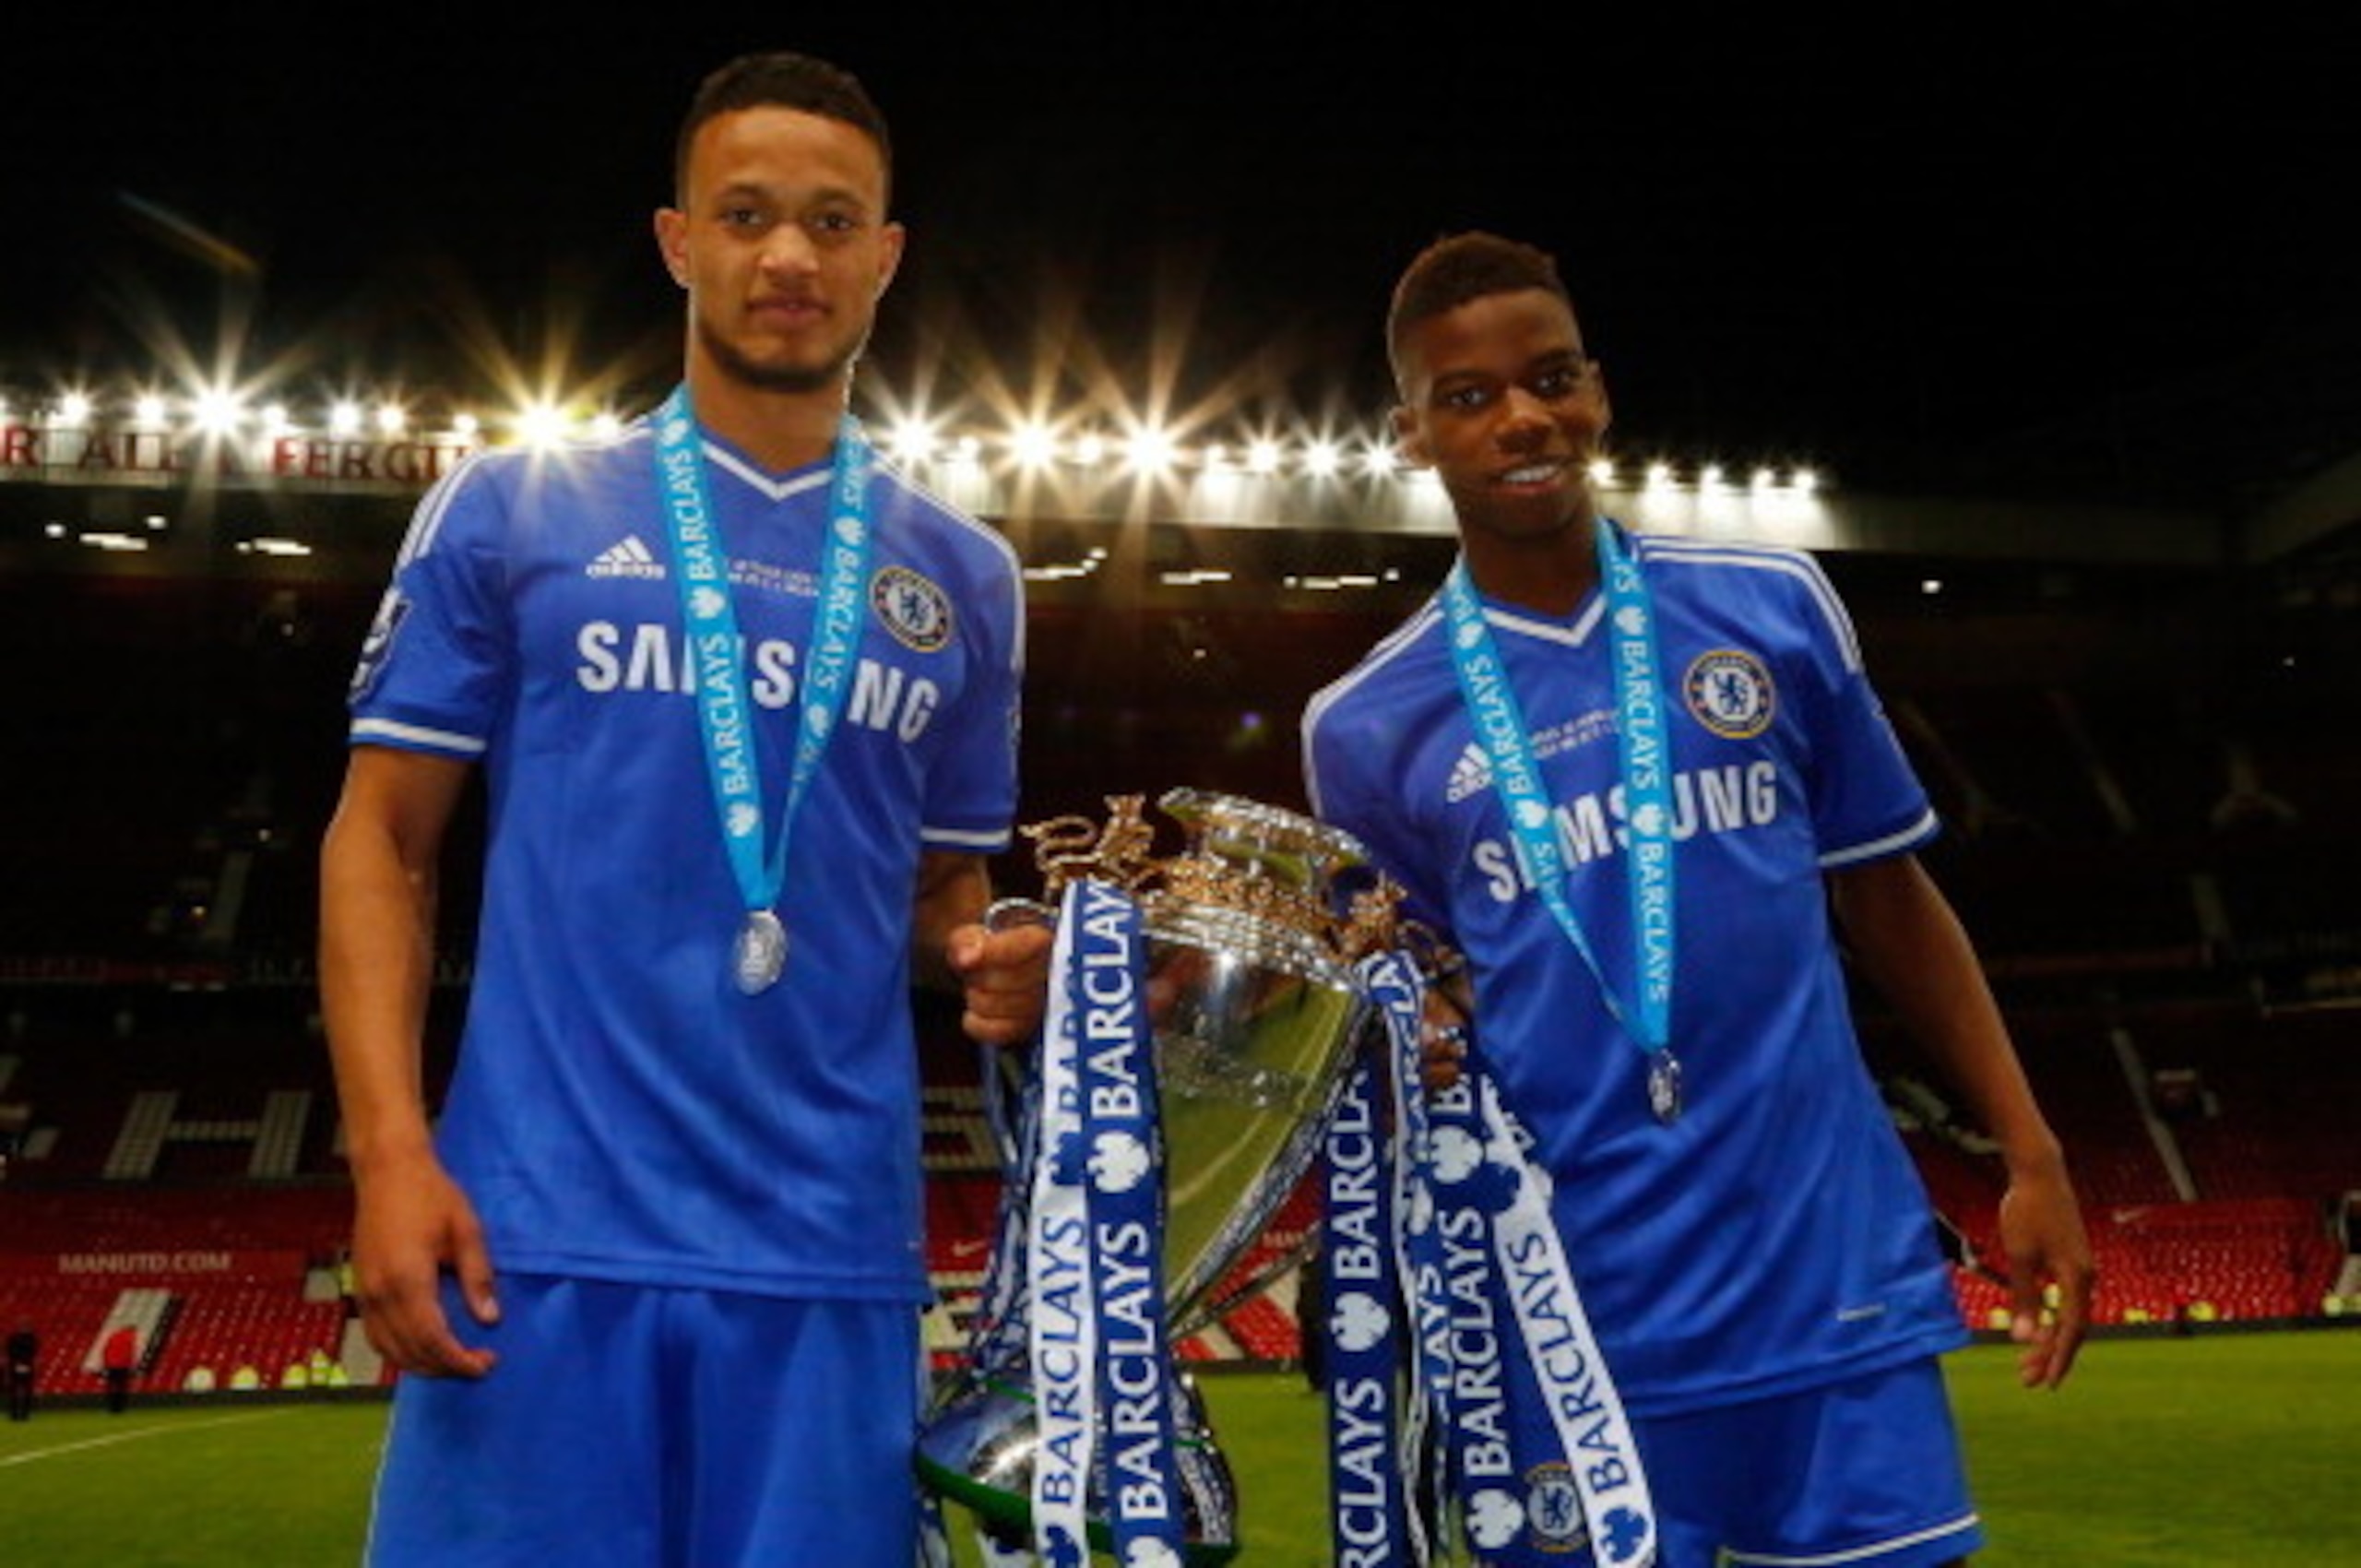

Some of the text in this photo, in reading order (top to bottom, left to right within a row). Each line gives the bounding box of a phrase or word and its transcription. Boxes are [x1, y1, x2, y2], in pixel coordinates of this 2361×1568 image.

[663, 448, 717, 580] BARCLAYS
[577, 621, 940, 743] SASNG
[813, 546, 861, 690] BARCLAYS
[698, 631, 753, 796] BARCLAYS
[1465, 653, 1534, 796] BARCLAYS
[1620, 641, 1660, 790] BARCLAYS
[1473, 758, 1776, 903] SMUNG
[1637, 842, 1671, 1003] BARCLAYS
[59, 1252, 231, 1274] MANUTD.COM
[1039, 1215, 1087, 1507] BARCLAYS
[1097, 1222, 1169, 1520] BARCLAYS
[1437, 1206, 1513, 1476] BARCLAYS
[1508, 1232, 1631, 1494] BARCLAYS
